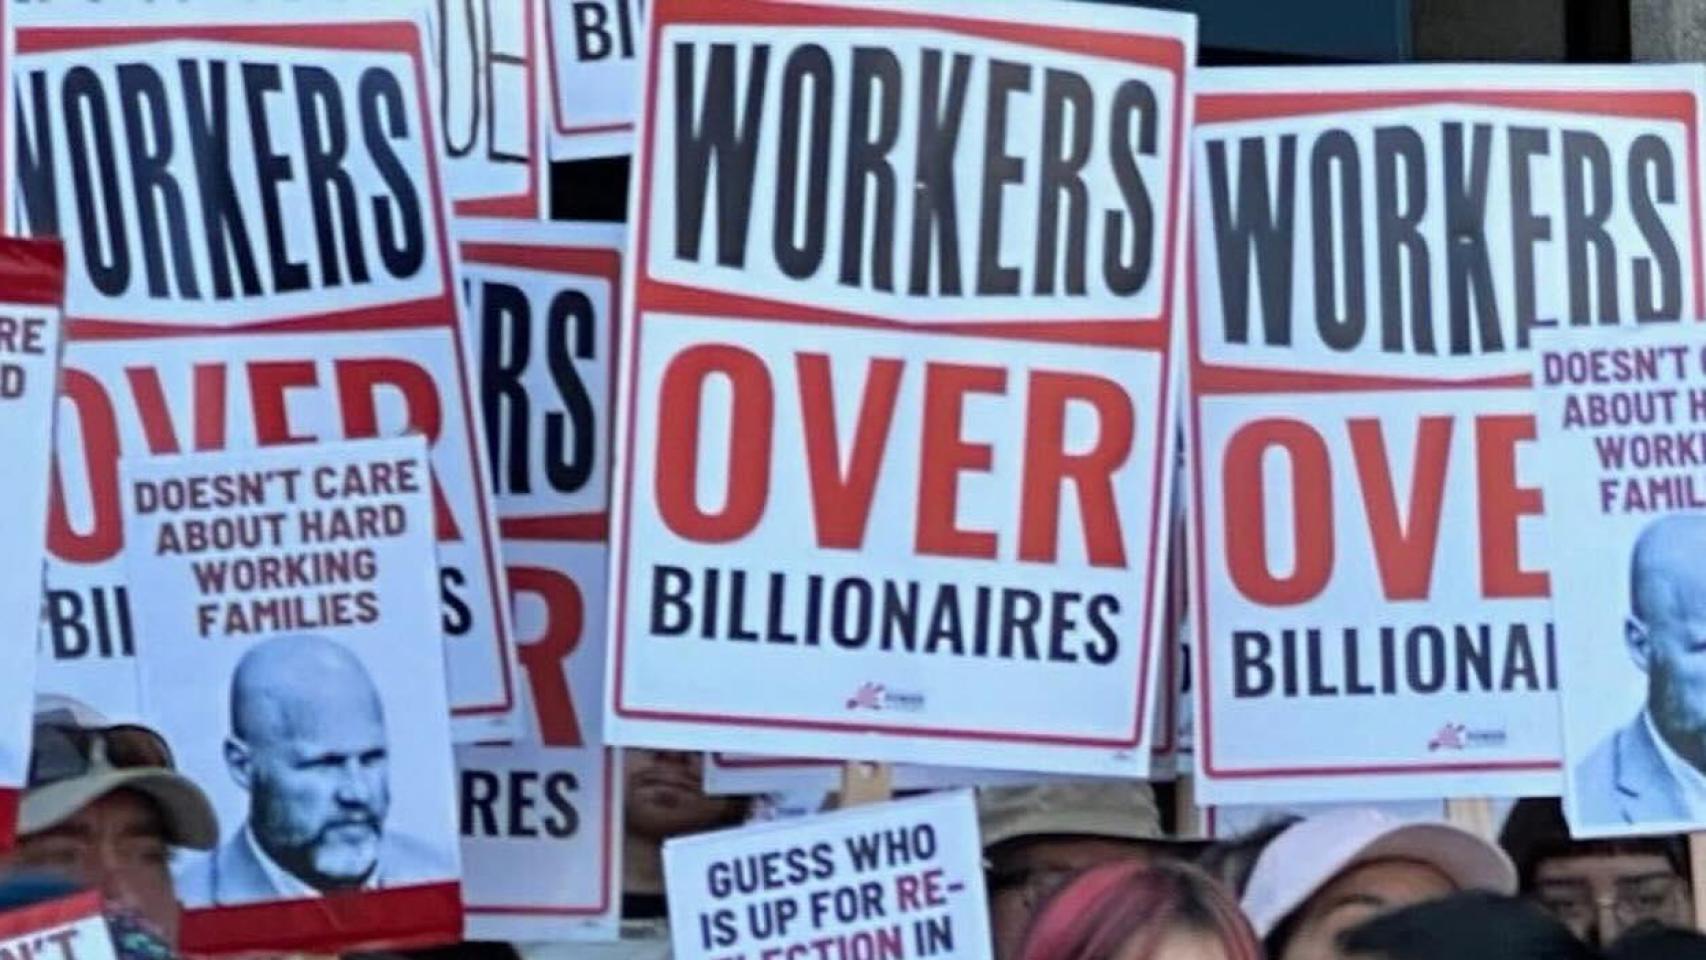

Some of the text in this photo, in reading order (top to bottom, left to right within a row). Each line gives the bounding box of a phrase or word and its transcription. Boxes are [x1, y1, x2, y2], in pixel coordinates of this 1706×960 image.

[573, 1, 646, 61] BI
[675, 42, 1159, 298] WORKERS
[1205, 121, 1682, 355] WORKERS
[1543, 346, 1688, 386] DOESN'T
[1562, 390, 1678, 429] ABOUT
[652, 343, 1136, 569] OVER
[134, 459, 420, 515] DOESN'T CARE
[1221, 414, 1552, 608] OVE
[157, 503, 407, 556] ABOUT HARD
[192, 548, 378, 595] WORKING
[197, 591, 380, 638] FAMILIES
[648, 564, 1123, 665] BILLIONAIRES
[707, 823, 937, 900] GUESS WHO
[699, 868, 965, 950] IS UP FOR RE-
[914, 915, 955, 957] IN
